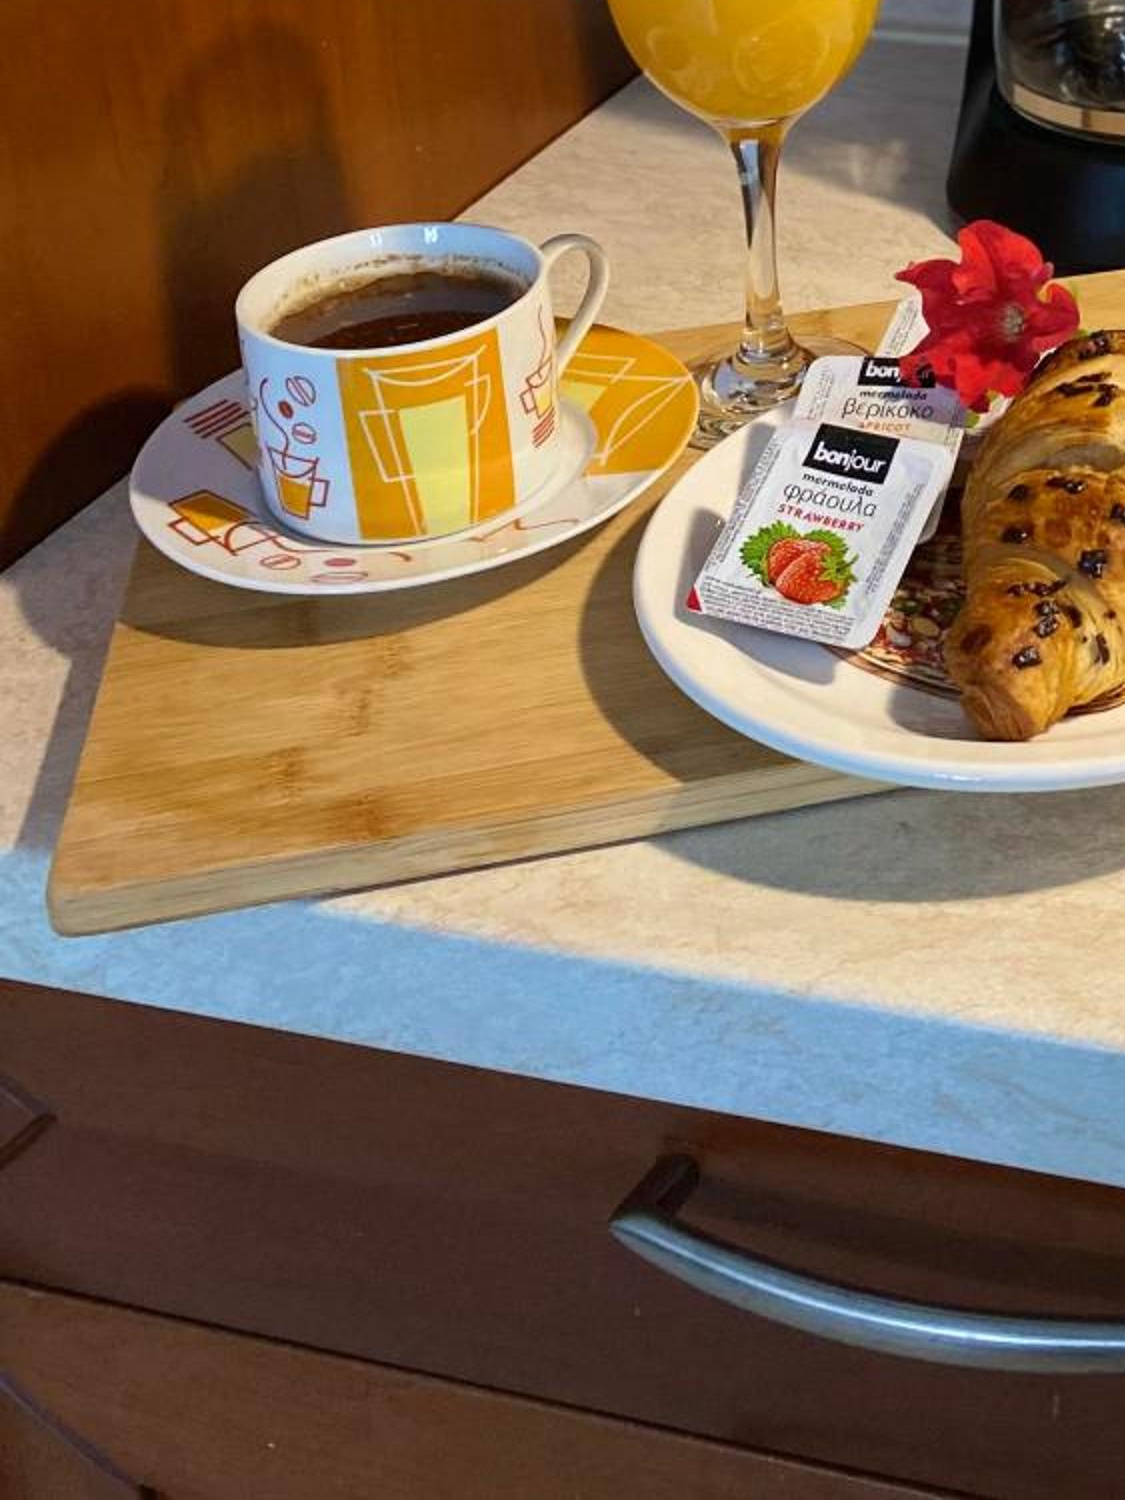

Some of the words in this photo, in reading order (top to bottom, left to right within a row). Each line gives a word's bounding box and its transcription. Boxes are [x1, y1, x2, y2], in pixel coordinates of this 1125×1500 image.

[813, 440, 886, 473] bonjour
[783, 484, 878, 517] φράουλα
[802, 473, 874, 497] mermelada
[777, 503, 865, 533] STRAWBERRY
